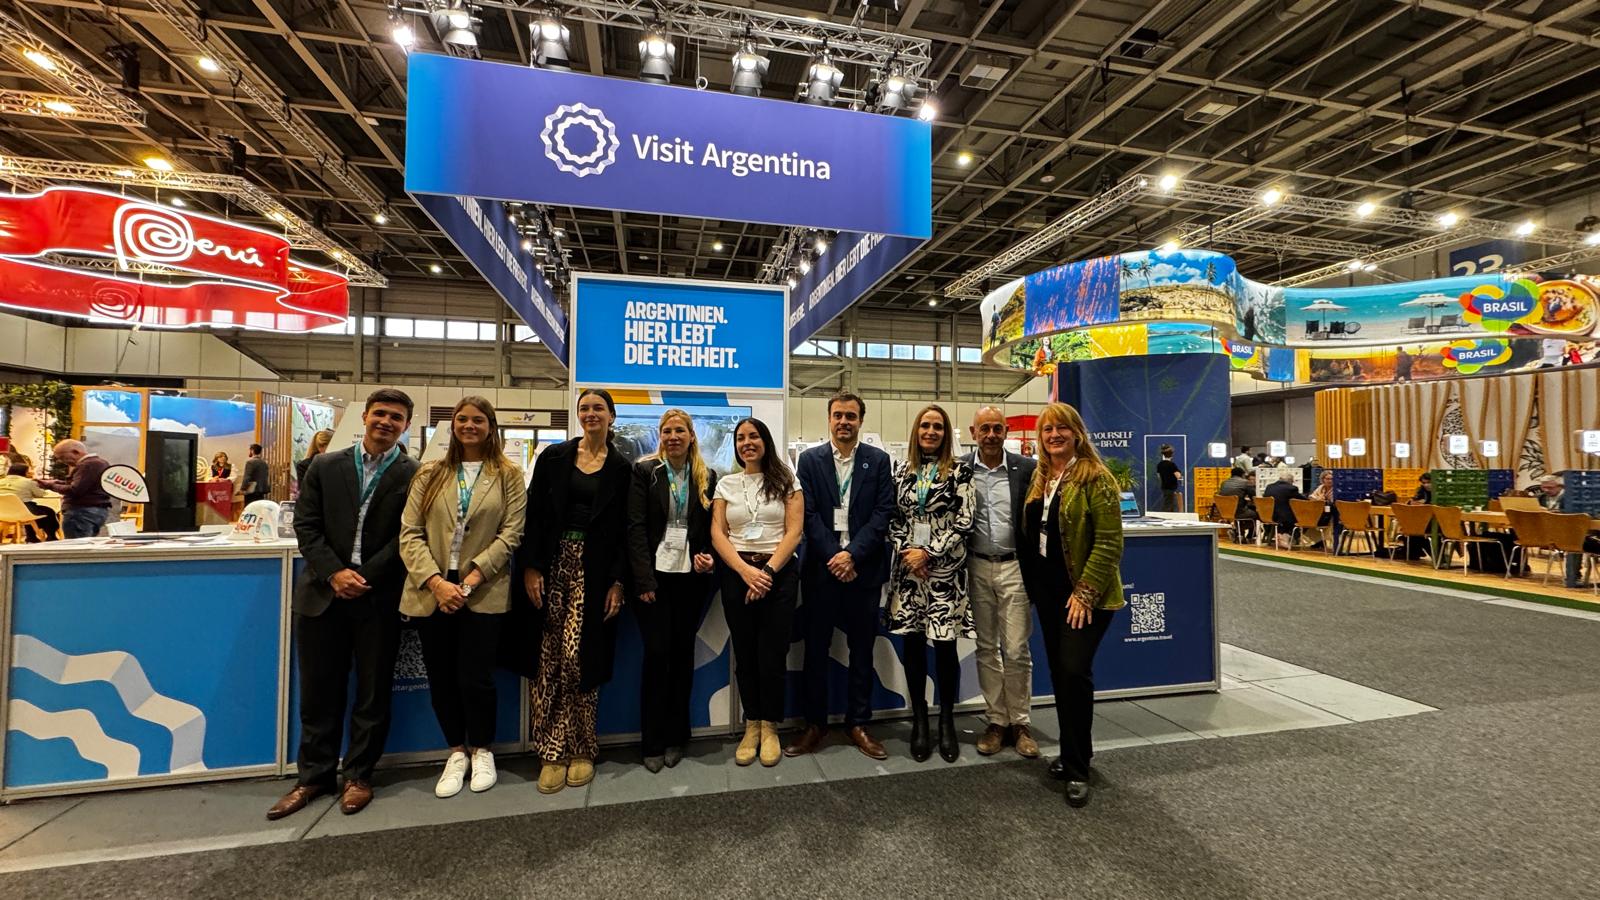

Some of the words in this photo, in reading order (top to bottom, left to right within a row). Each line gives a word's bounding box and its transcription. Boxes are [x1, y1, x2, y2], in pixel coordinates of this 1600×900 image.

[632, 133, 694, 165] Visit
[701, 142, 831, 180] Argentina
[113, 202, 264, 271] Perú
[624, 301, 728, 324] ARGENTINIEN.
[1483, 301, 1528, 313] BRASIL
[624, 320, 668, 343] HIER
[671, 322, 716, 346] LEBT
[624, 342, 654, 366] DIE
[657, 344, 740, 369] FREIHEIT.
[1231, 344, 1253, 355] BRASIL
[1458, 348, 1497, 360] BRASIL
[1093, 431, 1135, 440] YOURSELF
[1100, 439, 1131, 448] BRAZIL
